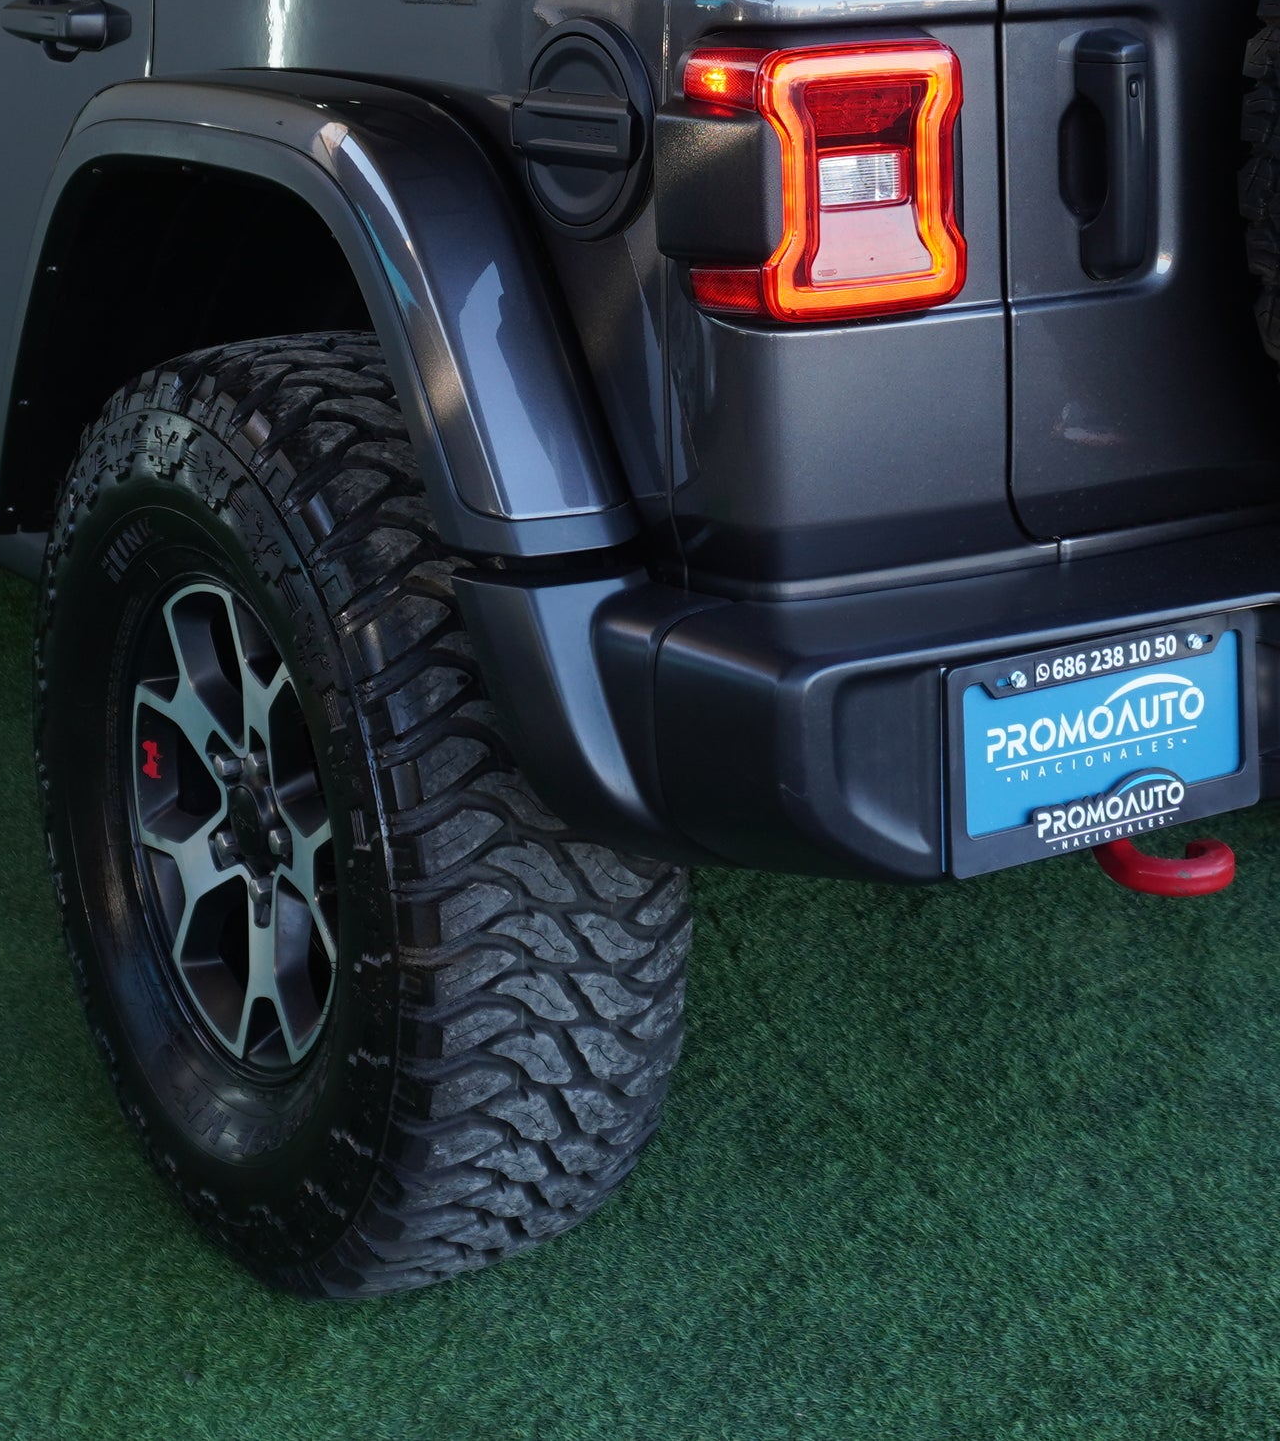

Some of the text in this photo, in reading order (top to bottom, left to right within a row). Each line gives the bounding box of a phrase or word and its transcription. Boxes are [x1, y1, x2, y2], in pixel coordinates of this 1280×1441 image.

[1052, 634, 1177, 681] 686 238 10 50
[986, 685, 1205, 764] PROMOAUTO
[1021, 738, 1174, 782] NACIONALES
[1037, 780, 1185, 839] PROMOAUTO
[1062, 816, 1165, 851] NACIONALES
